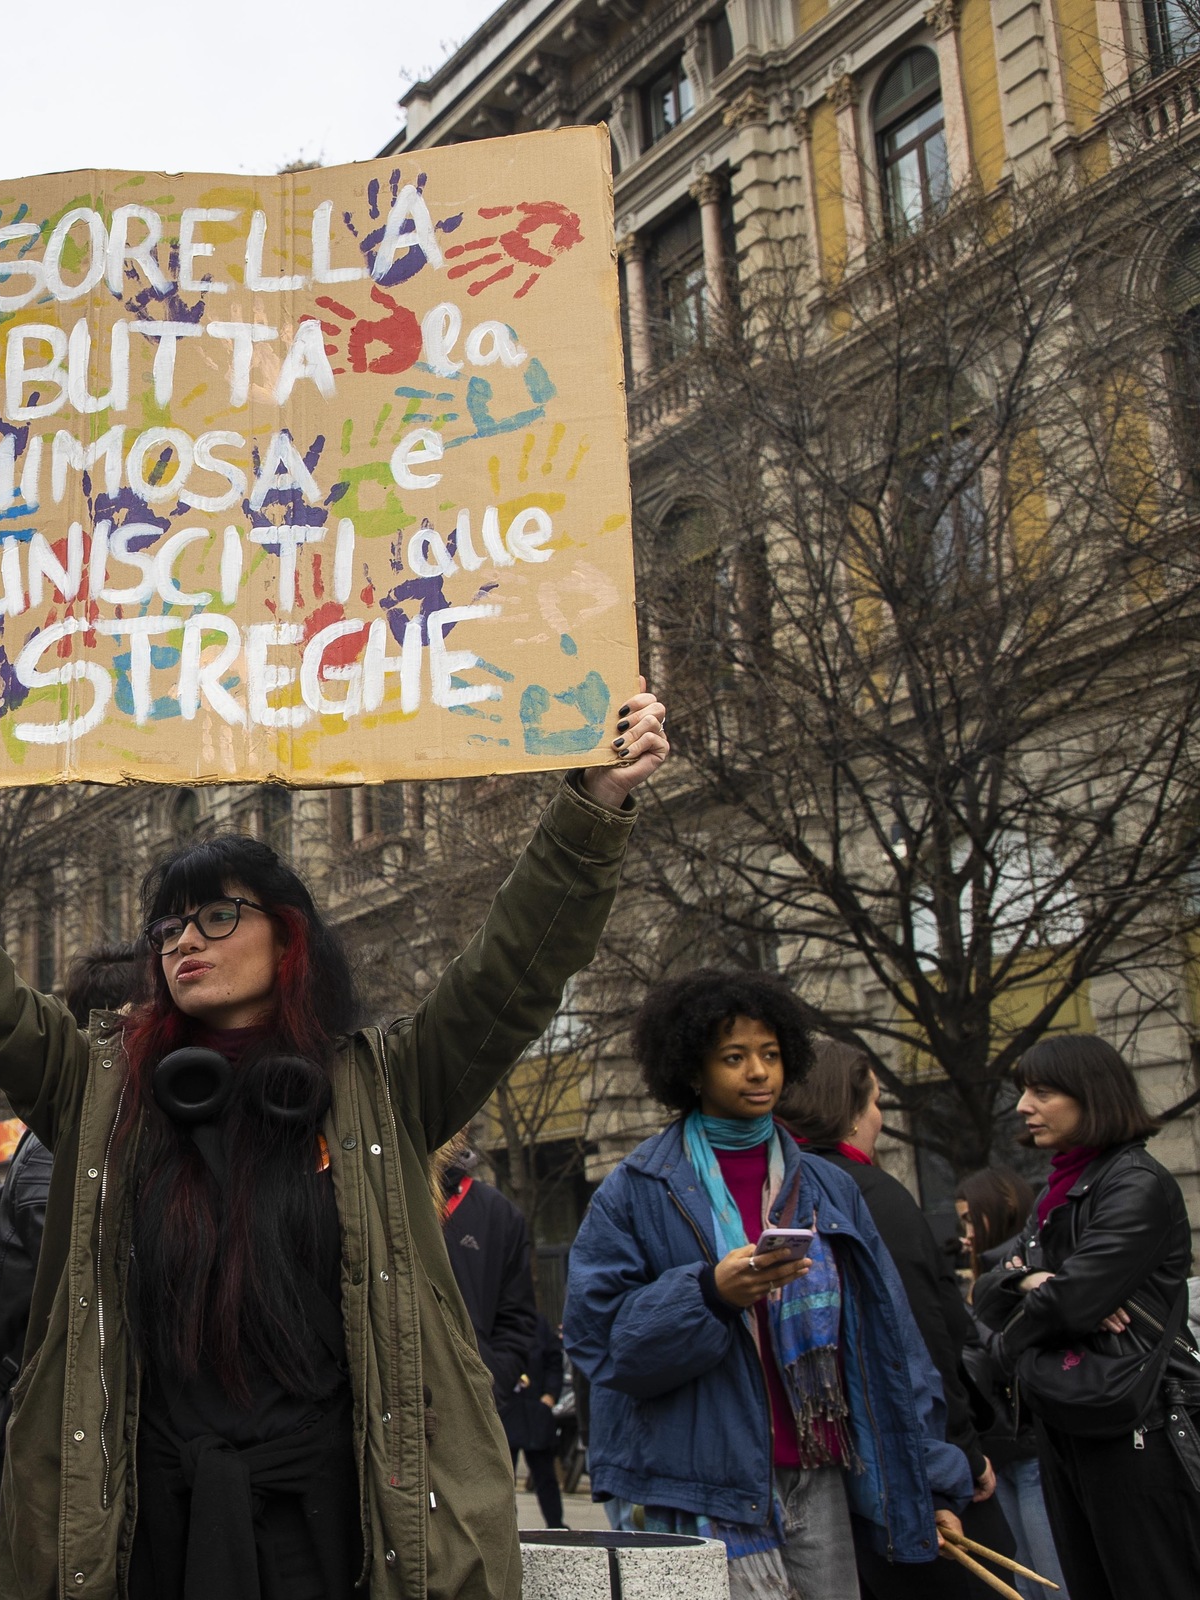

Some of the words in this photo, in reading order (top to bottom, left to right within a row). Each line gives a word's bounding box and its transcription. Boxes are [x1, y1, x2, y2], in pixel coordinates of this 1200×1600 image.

[5, 318, 336, 421] BUTTA
[422, 302, 527, 378] la
[390, 428, 444, 490] e
[408, 505, 556, 578] alle
[12, 604, 503, 745] STREGHE
